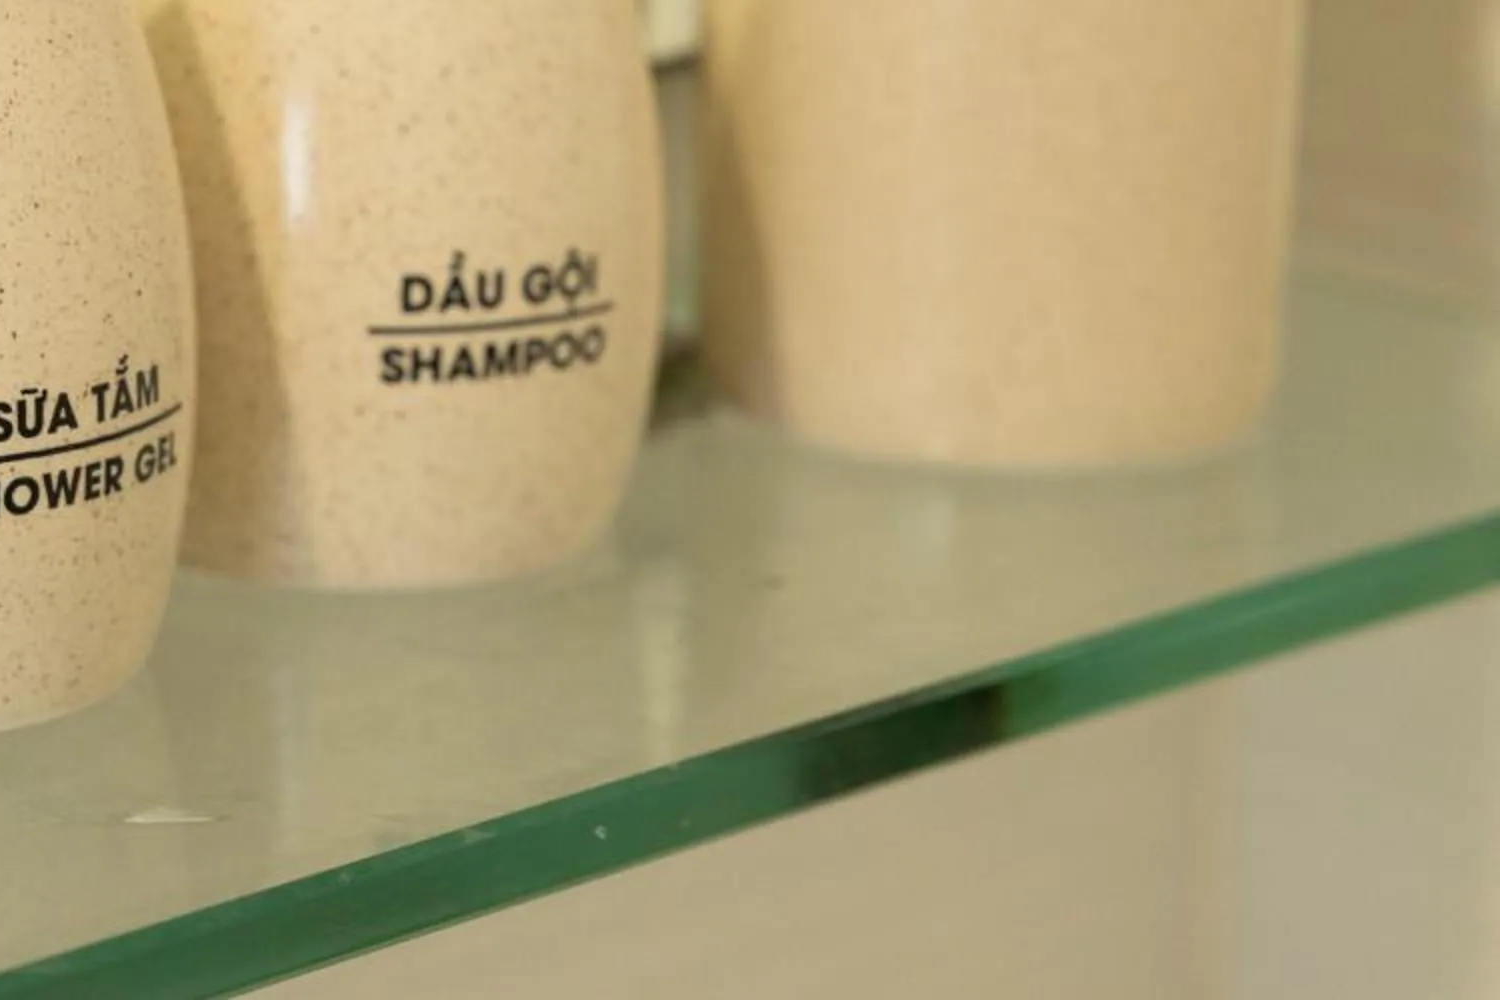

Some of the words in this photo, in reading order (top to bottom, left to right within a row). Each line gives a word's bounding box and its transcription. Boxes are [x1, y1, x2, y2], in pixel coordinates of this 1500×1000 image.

[380, 326, 606, 384] SHAMPOO
[91, 353, 160, 423] TẮM
[134, 432, 177, 482] GEL
